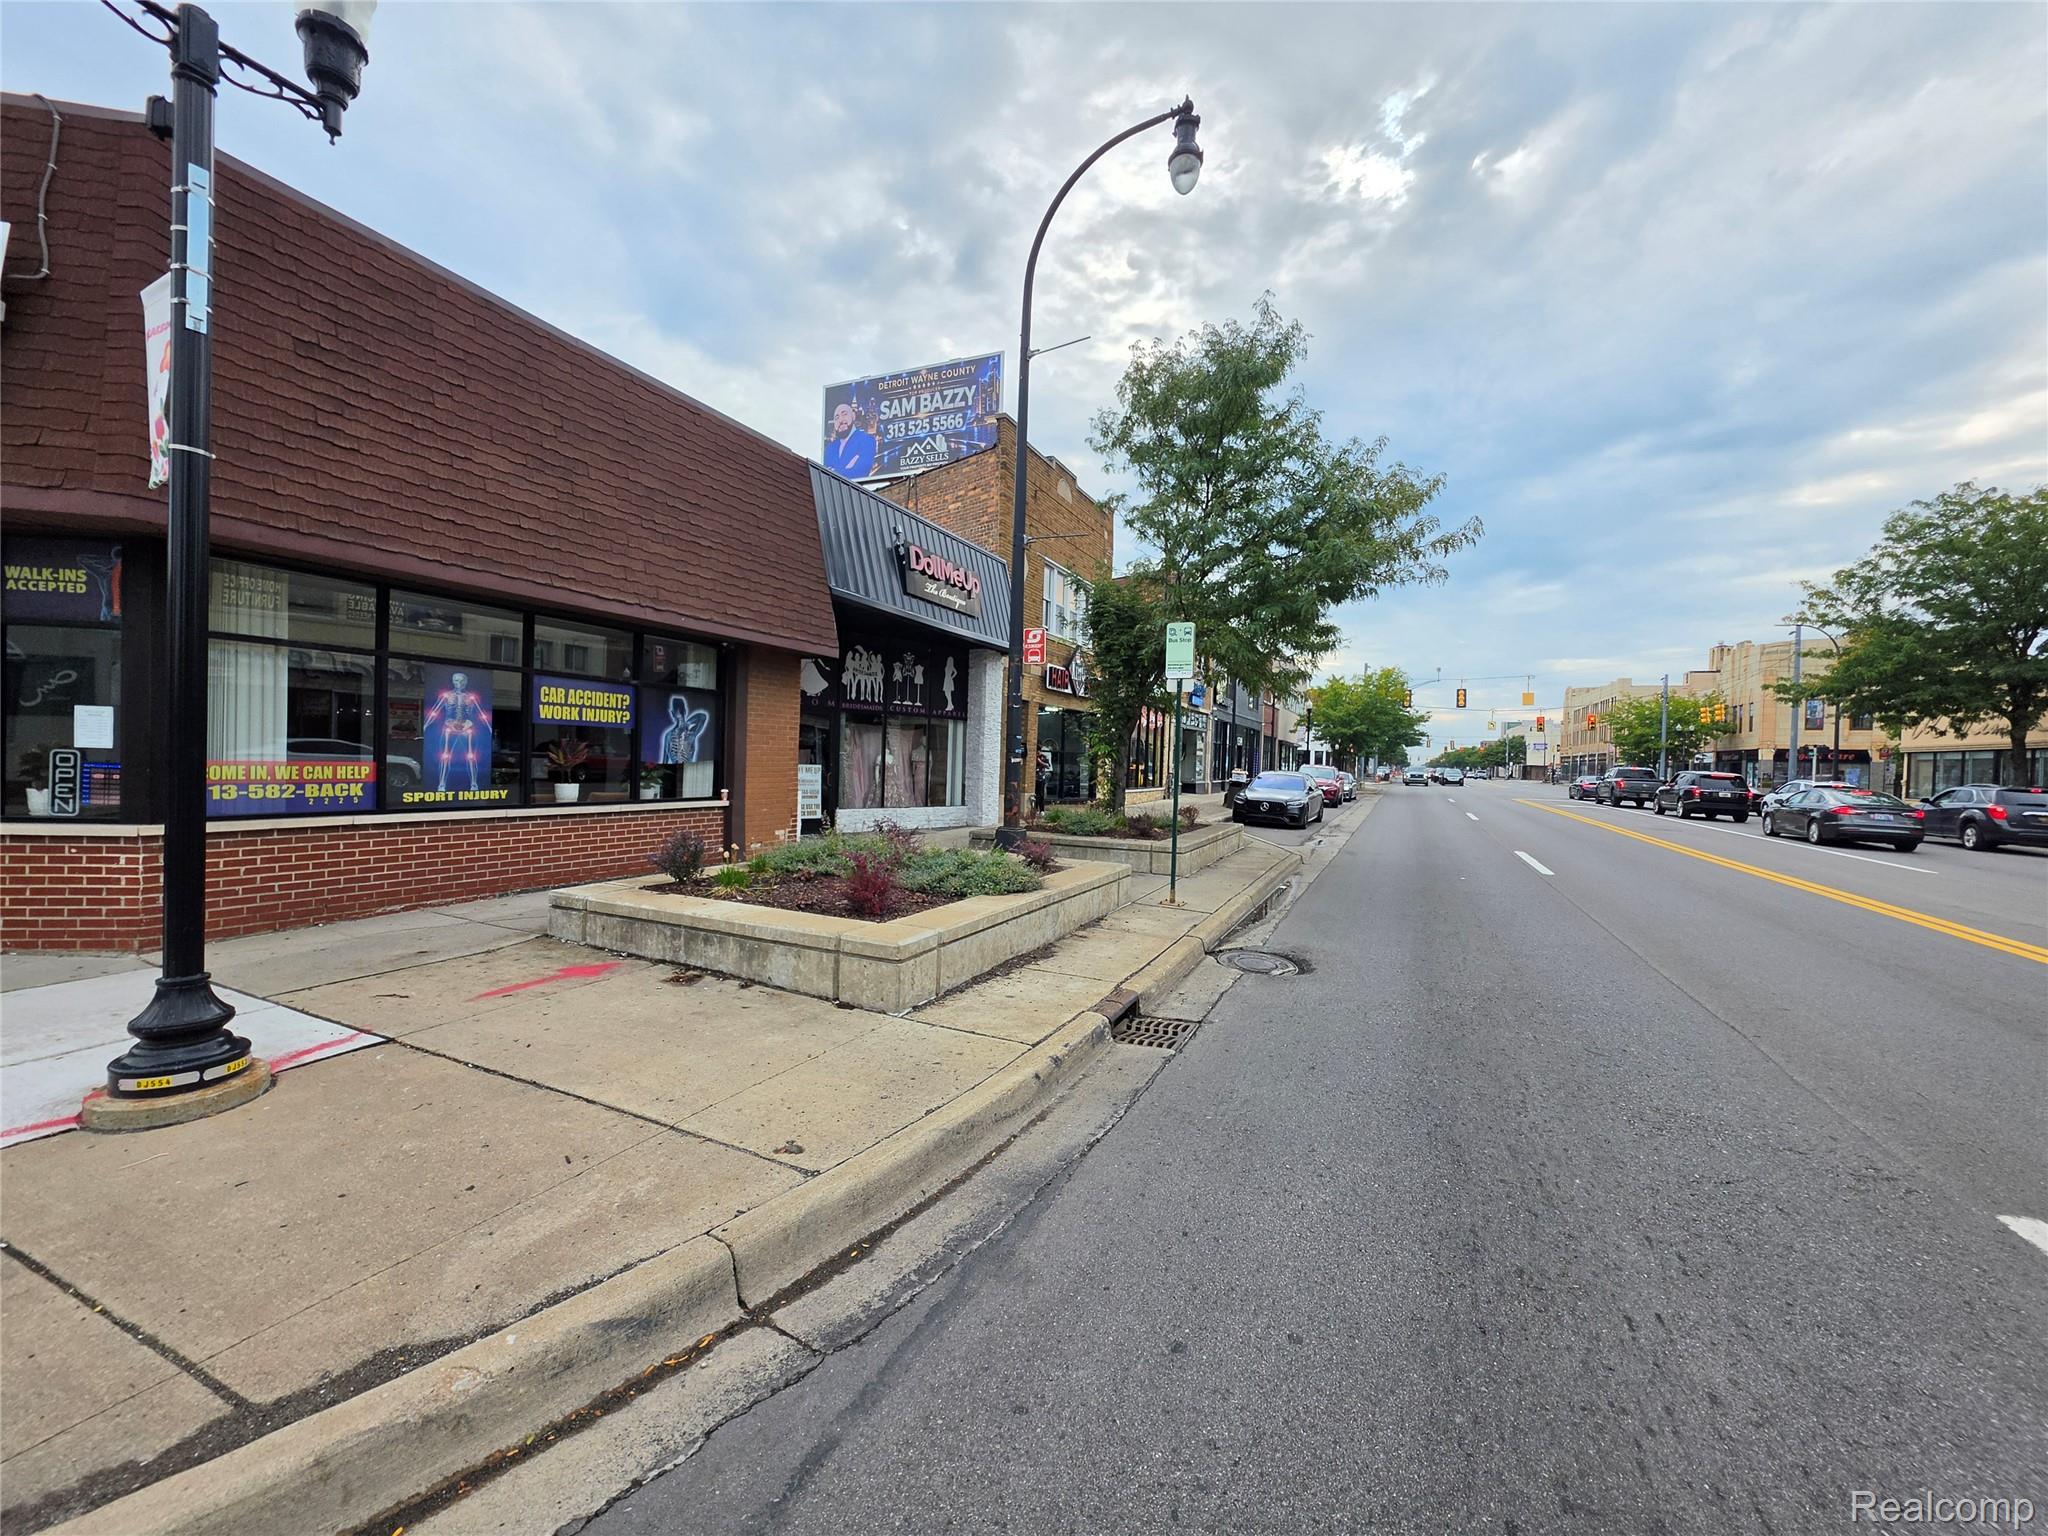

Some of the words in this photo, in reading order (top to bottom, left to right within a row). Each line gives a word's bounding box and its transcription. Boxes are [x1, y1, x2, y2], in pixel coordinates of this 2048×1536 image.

[878, 377, 909, 391] DETROIT
[910, 372, 939, 384] WAYNE
[941, 365, 976, 379] COUNTY
[880, 396, 916, 420] SAM
[919, 385, 976, 414] BAZZY
[886, 422, 906, 439] 313
[908, 419, 930, 436] 525
[932, 413, 963, 432] 5566
[900, 455, 925, 466] BAZZY
[926, 452, 949, 463] SELLS
[4, 565, 87, 582] WALK-INS
[5, 579, 87, 594] ACCEPTED
[1051, 666, 1070, 690] HAIR
[539, 686, 565, 704] CAR
[567, 688, 631, 710] ACCIDENT?
[539, 704, 579, 721] WORK
[581, 706, 631, 724] INJURY?
[889, 705, 926, 714] CUSTOM
[206, 765, 246, 780] OME
[250, 765, 270, 781] IN,
[275, 765, 299, 780] WE
[302, 765, 332, 779] CAN
[336, 765, 370, 779] HELP
[55, 754, 75, 813] OPEN
[402, 791, 454, 804] SPORT
[457, 790, 508, 802] INJURY
